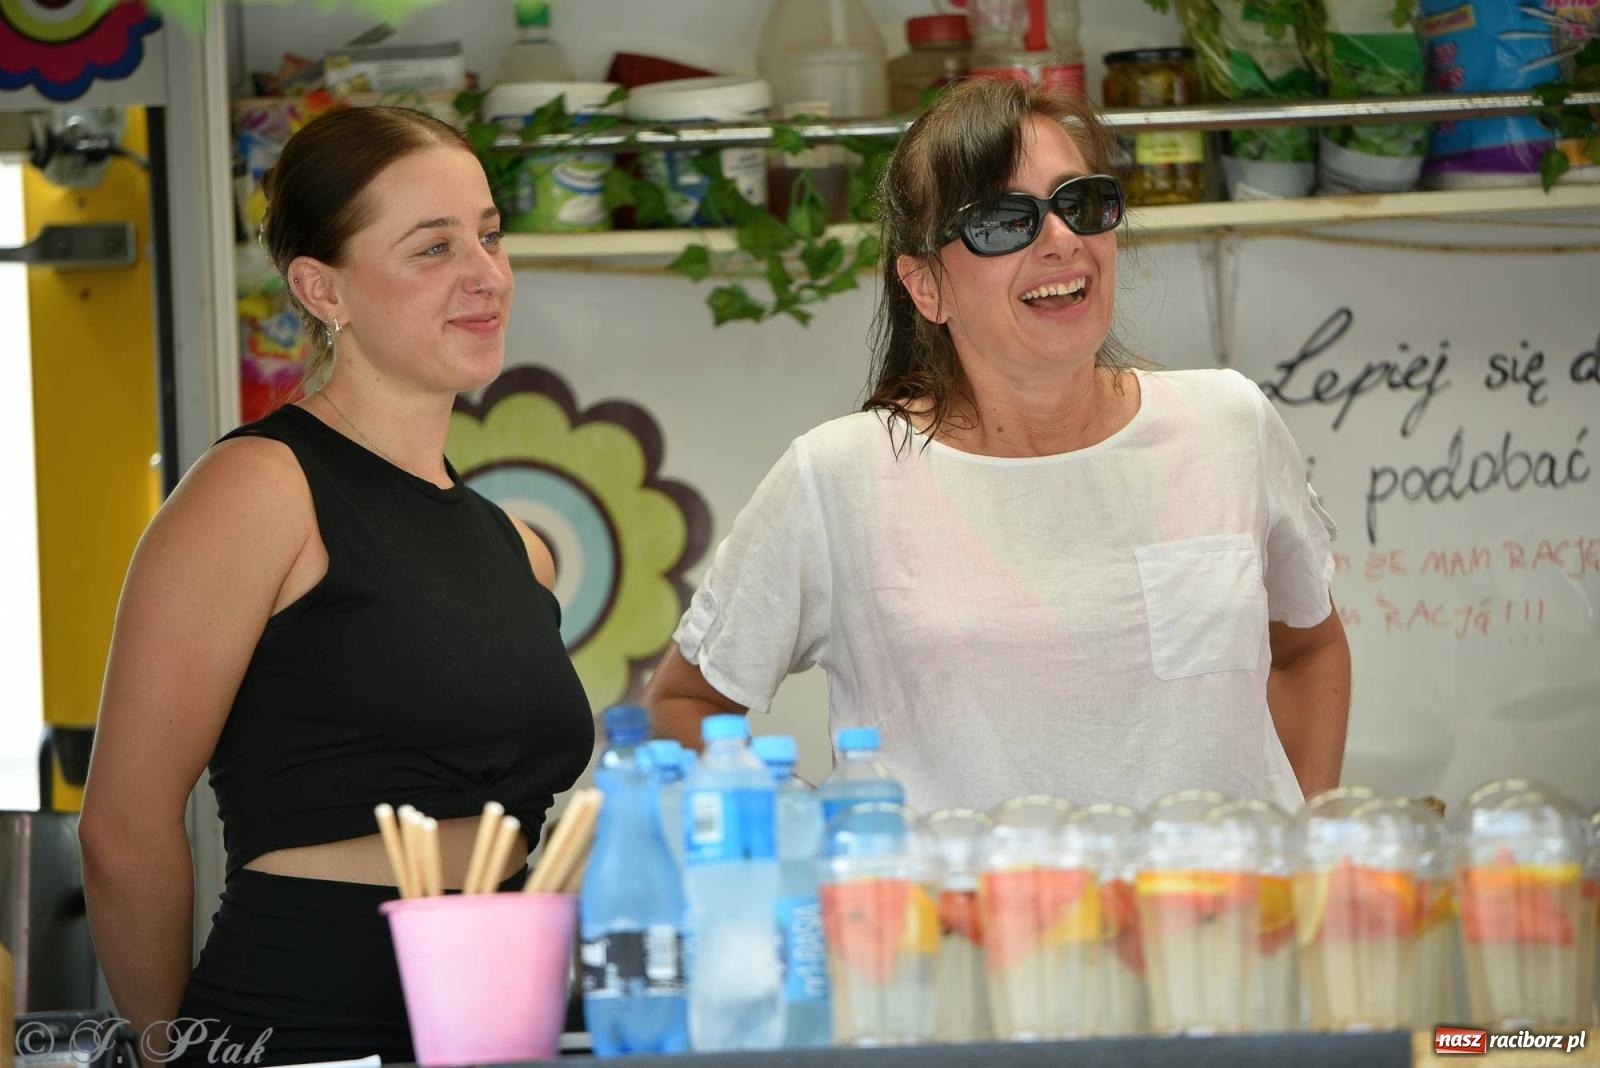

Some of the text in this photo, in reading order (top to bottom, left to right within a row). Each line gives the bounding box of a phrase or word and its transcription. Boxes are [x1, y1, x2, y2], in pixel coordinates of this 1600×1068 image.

[1263, 306, 1451, 437] Lepiej
[1484, 340, 1548, 408] się
[1365, 425, 1592, 546] podobać
